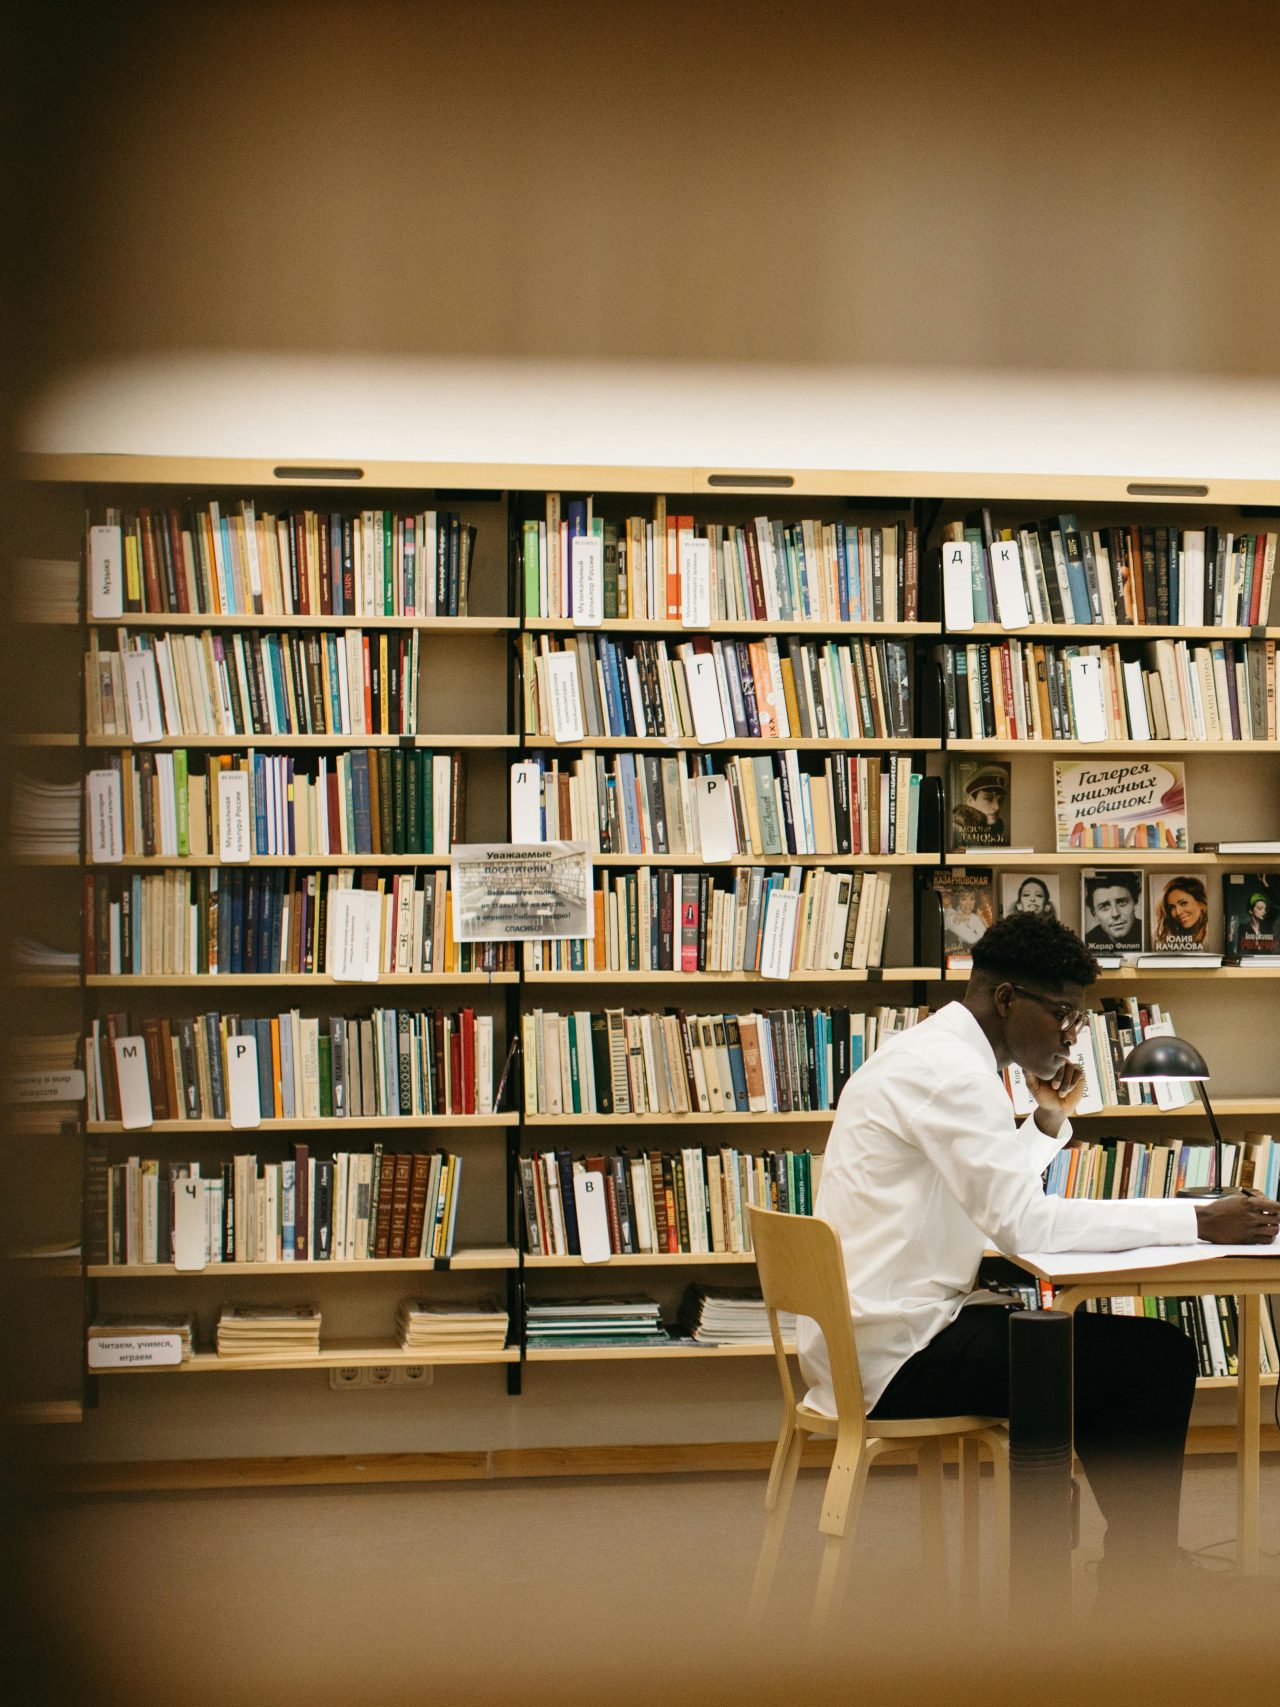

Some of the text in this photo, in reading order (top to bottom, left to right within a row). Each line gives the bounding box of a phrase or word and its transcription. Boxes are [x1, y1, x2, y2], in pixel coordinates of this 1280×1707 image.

[951, 551, 963, 565] Д
[1001, 549, 1010, 561] К
[103, 559, 111, 595] Музыка
[576, 560, 586, 614] Музыкальный
[587, 582, 597, 619] фольклор
[697, 664, 704, 675] Г
[980, 647, 990, 693] ПУЧЧИНИ
[1081, 664, 1088, 674] Т
[516, 772, 527, 784] Л
[1078, 763, 1151, 786] Галерея
[707, 781, 716, 794] Р
[1071, 777, 1157, 803] книжных
[1075, 790, 1154, 818] новинок!
[225, 796, 233, 848] Музыкальная
[235, 819, 243, 852] культура
[486, 851, 552, 860] Уважаемые
[484, 865, 547, 874] посетители
[504, 925, 543, 933] СПАСИБО!
[1166, 935, 1193, 943] ЮЛИЯ
[1088, 942, 1141, 951] Жерар Филип
[1155, 943, 1204, 951] НАЧАЛОВА
[123, 1046, 137, 1059] М
[235, 1046, 246, 1059] Р
[185, 1186, 196, 1199] Ч
[585, 1182, 594, 1193] В
[98, 1341, 173, 1350] Читаем, учимся,
[119, 1354, 153, 1362] играем
